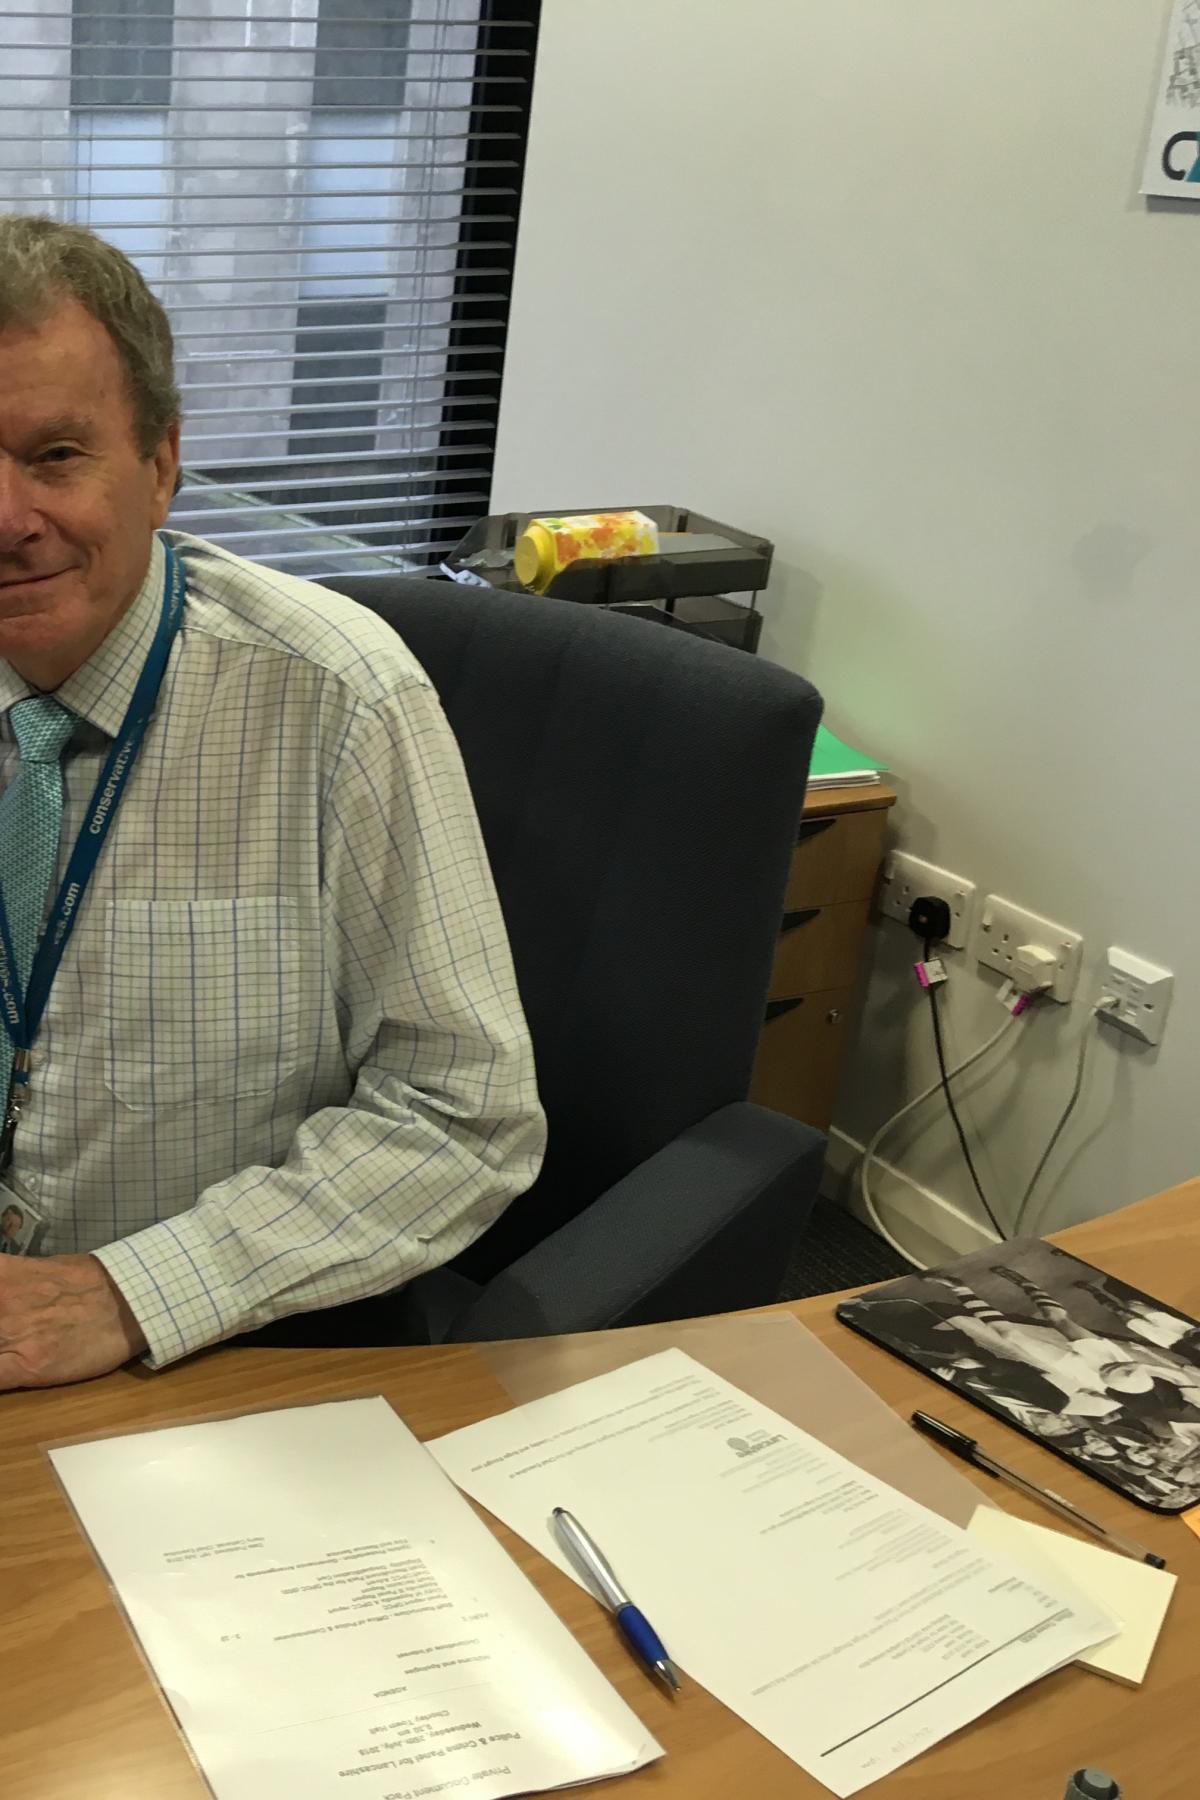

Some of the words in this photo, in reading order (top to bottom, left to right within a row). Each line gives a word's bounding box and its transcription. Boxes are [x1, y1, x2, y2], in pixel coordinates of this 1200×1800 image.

[478, 1737, 488, 1745] &
[488, 1732, 521, 1742] Police
[445, 1740, 477, 1752] Crime
[398, 1757, 414, 1765] for
[414, 1749, 446, 1762] Panel
[338, 1760, 397, 1777] Lancashire
[471, 1765, 512, 1780] Private
[412, 1776, 470, 1798] Document
[382, 1791, 413, 1800] Pack
